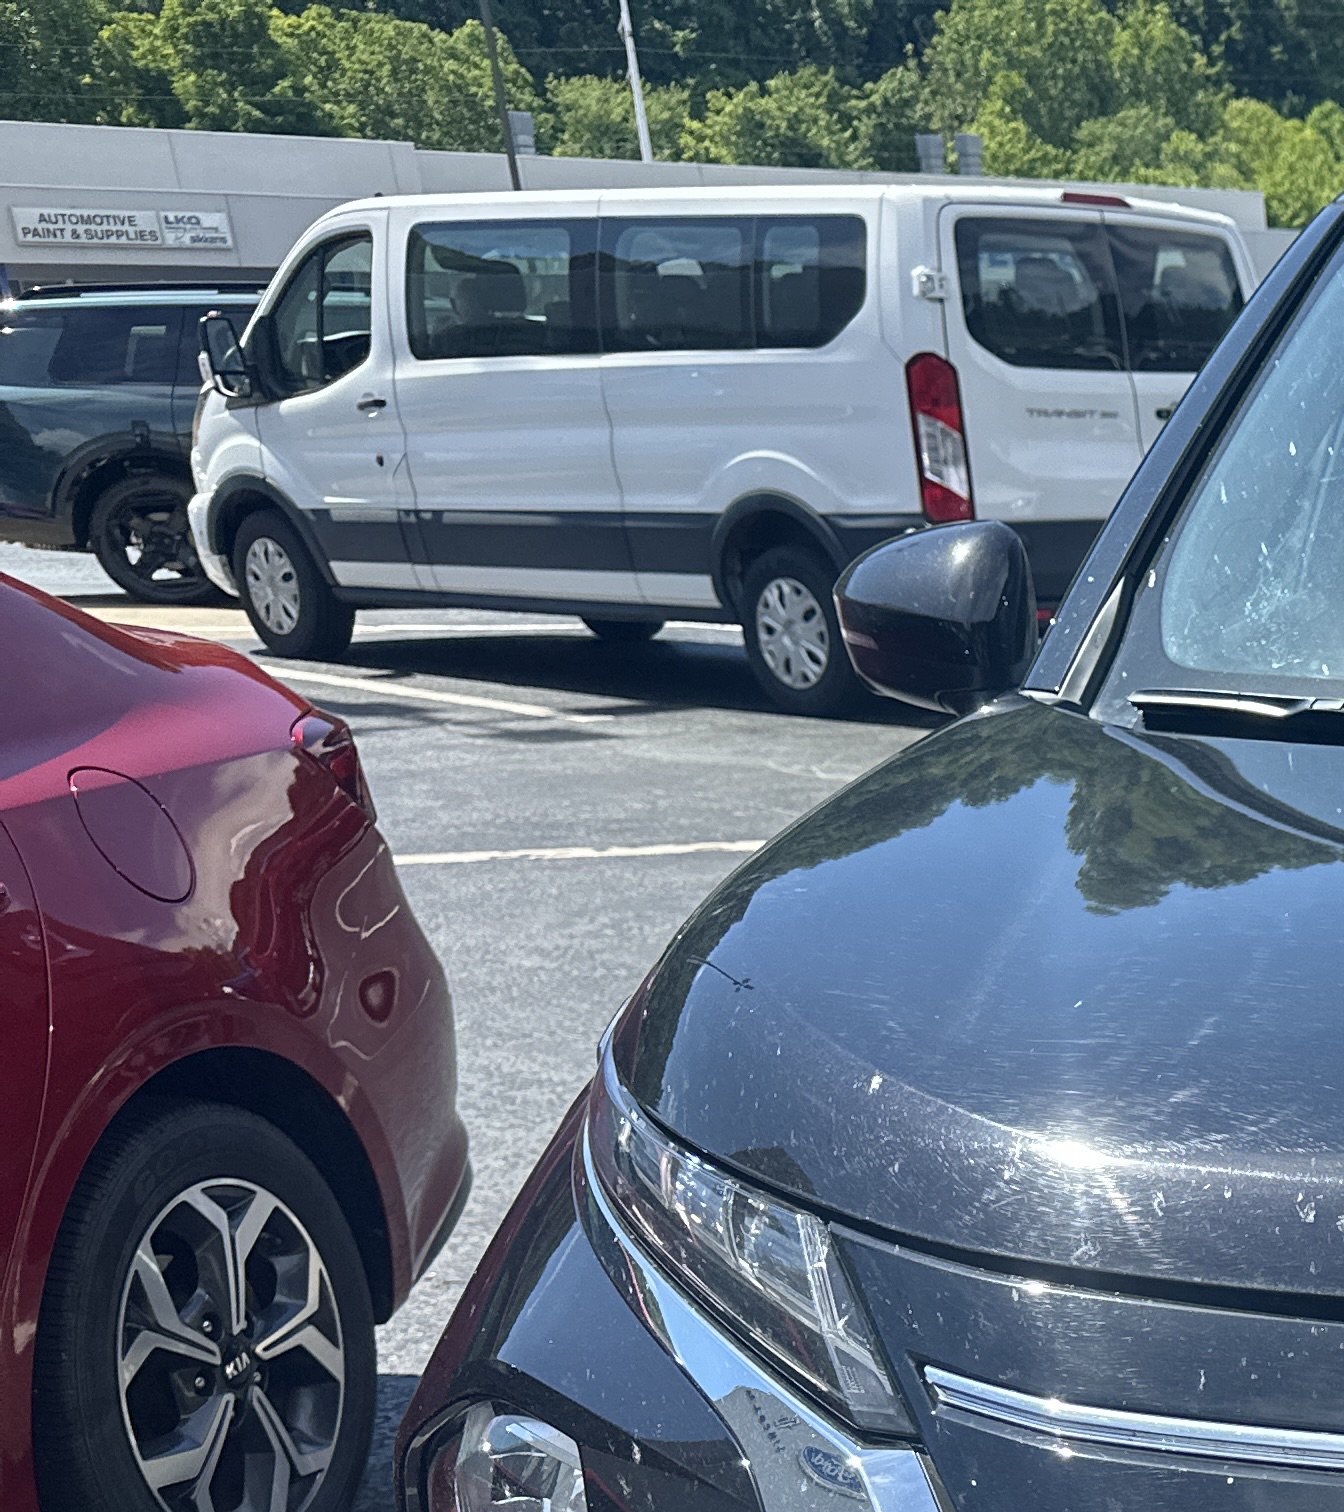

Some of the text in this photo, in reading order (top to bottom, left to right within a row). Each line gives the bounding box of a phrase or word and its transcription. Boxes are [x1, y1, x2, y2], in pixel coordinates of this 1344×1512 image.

[38, 213, 137, 227] AUTOMOTIVE
[164, 214, 201, 226] LKQ
[22, 227, 65, 239] PAINT
[70, 228, 80, 239] &
[84, 229, 158, 241] SUPPLIES
[1025, 407, 1098, 419] TRANSIT
[225, 1351, 250, 1380] KIA
